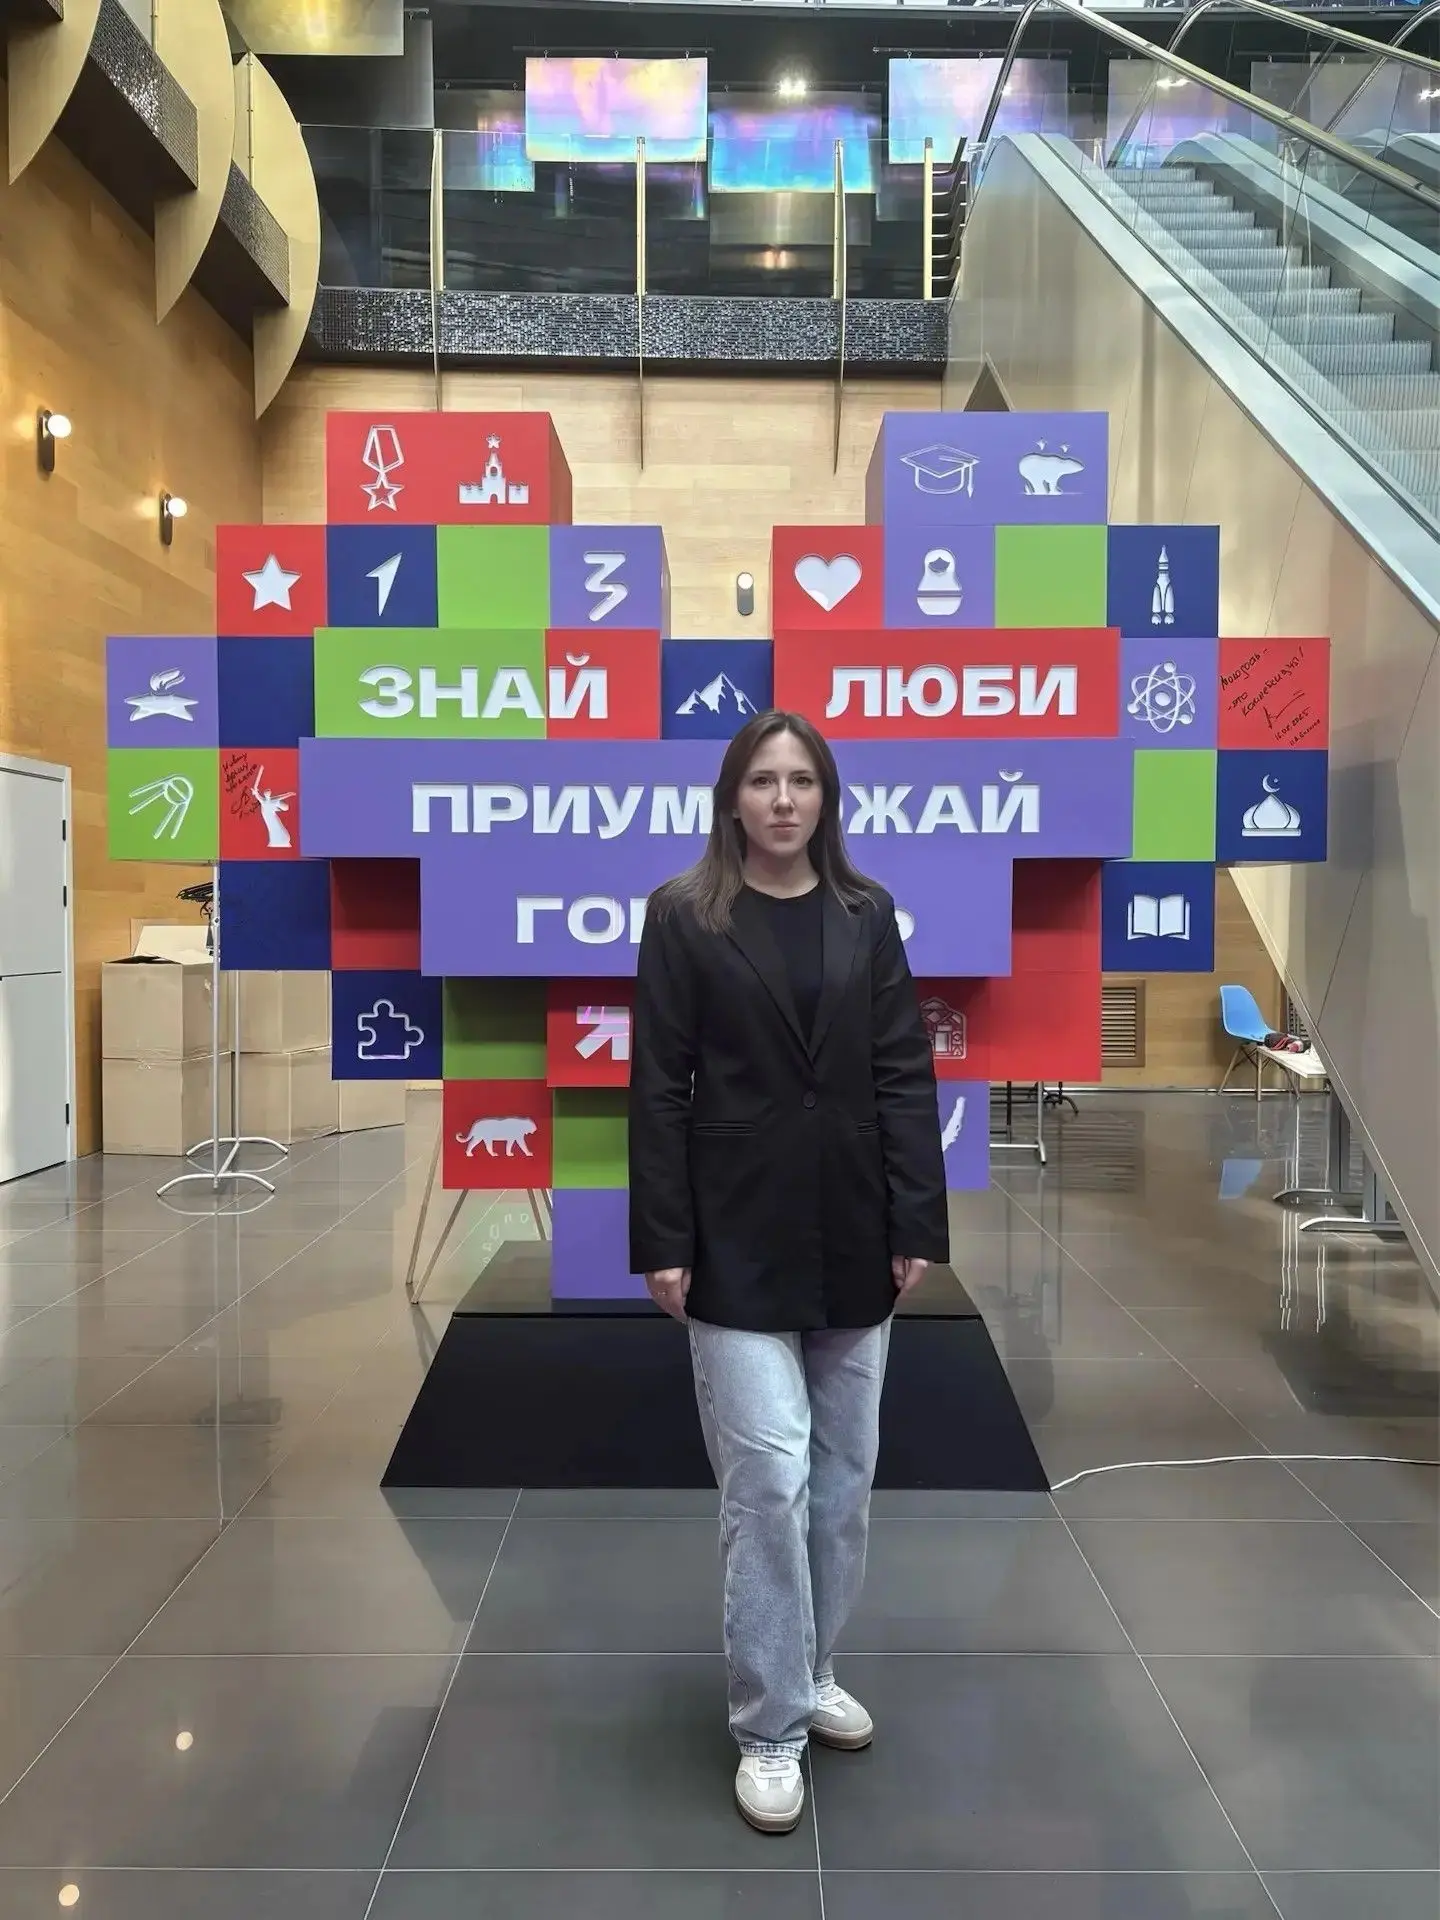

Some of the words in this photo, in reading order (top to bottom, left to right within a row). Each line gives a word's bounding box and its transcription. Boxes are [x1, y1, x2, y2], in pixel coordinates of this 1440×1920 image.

[357, 651, 610, 719] ЗНАЙ
[825, 663, 1079, 719] ЛЮБИ
[411, 768, 1041, 840] ПРИУМЖАЙ
